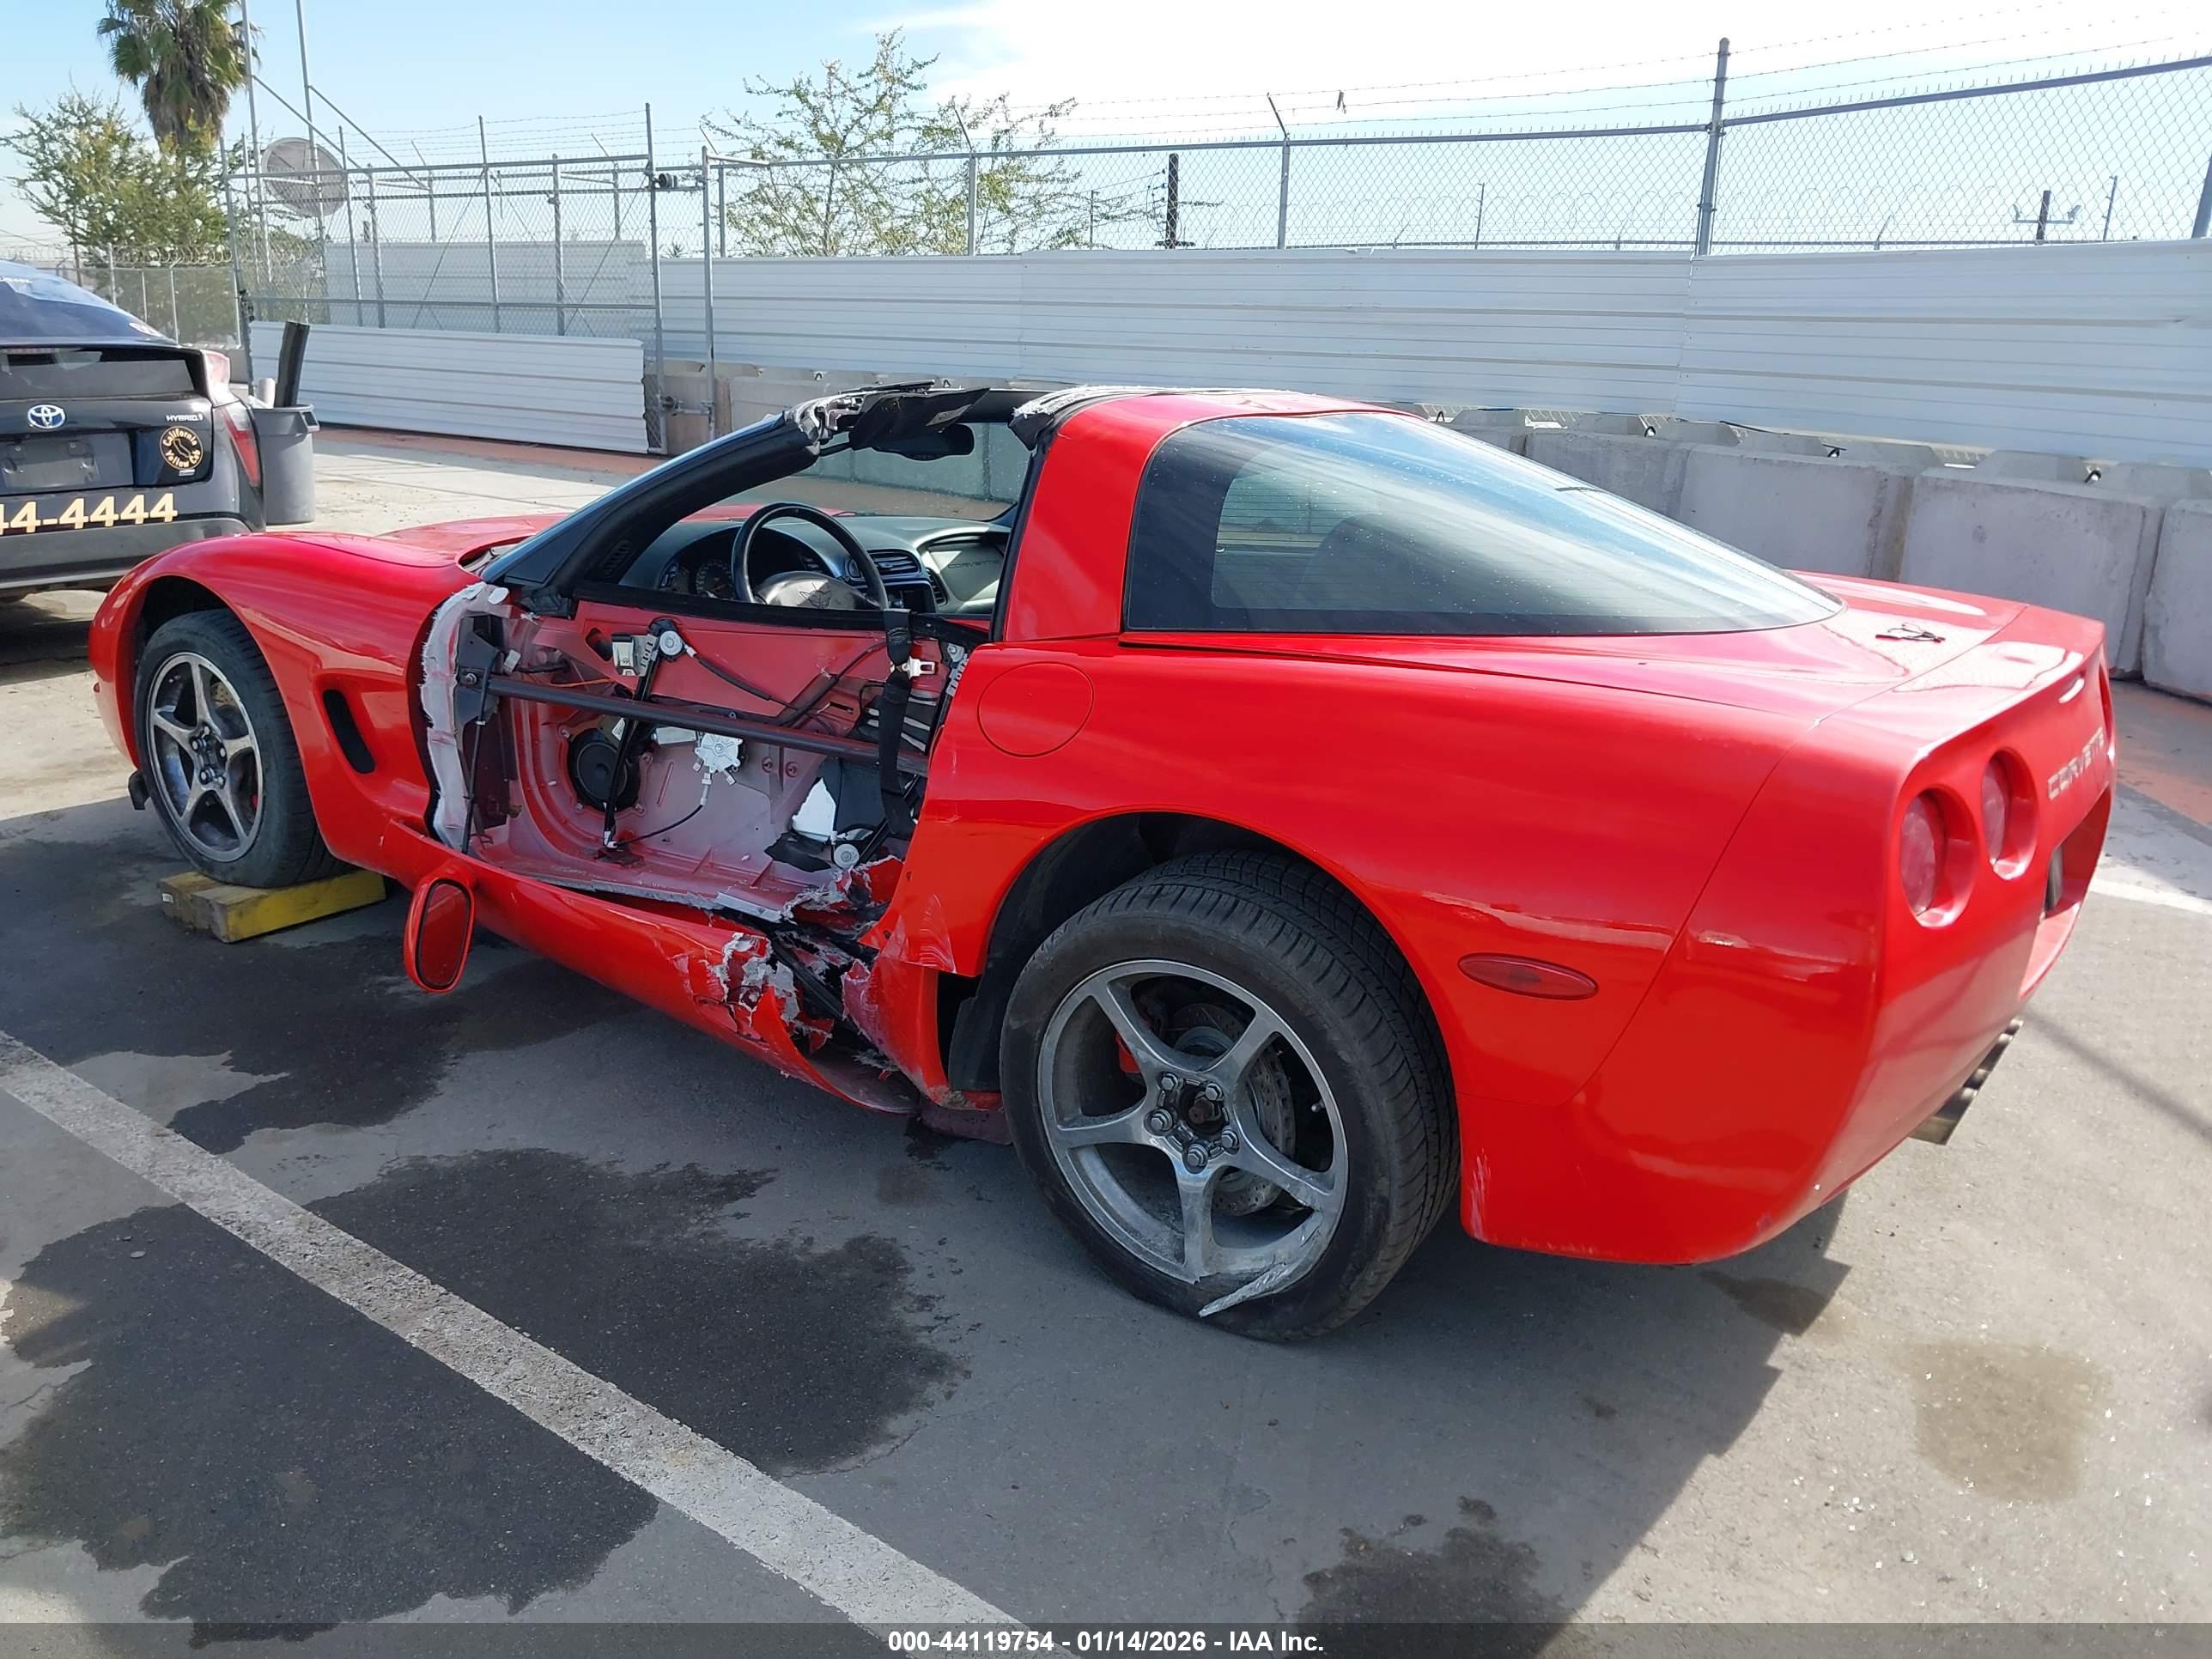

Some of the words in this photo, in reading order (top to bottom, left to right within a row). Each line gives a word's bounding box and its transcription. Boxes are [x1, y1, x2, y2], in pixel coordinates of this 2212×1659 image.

[163, 428, 198, 447] California
[165, 449, 190, 467] Yellow
[189, 449, 201, 465] Cab
[0, 493, 178, 536] 4-4444
